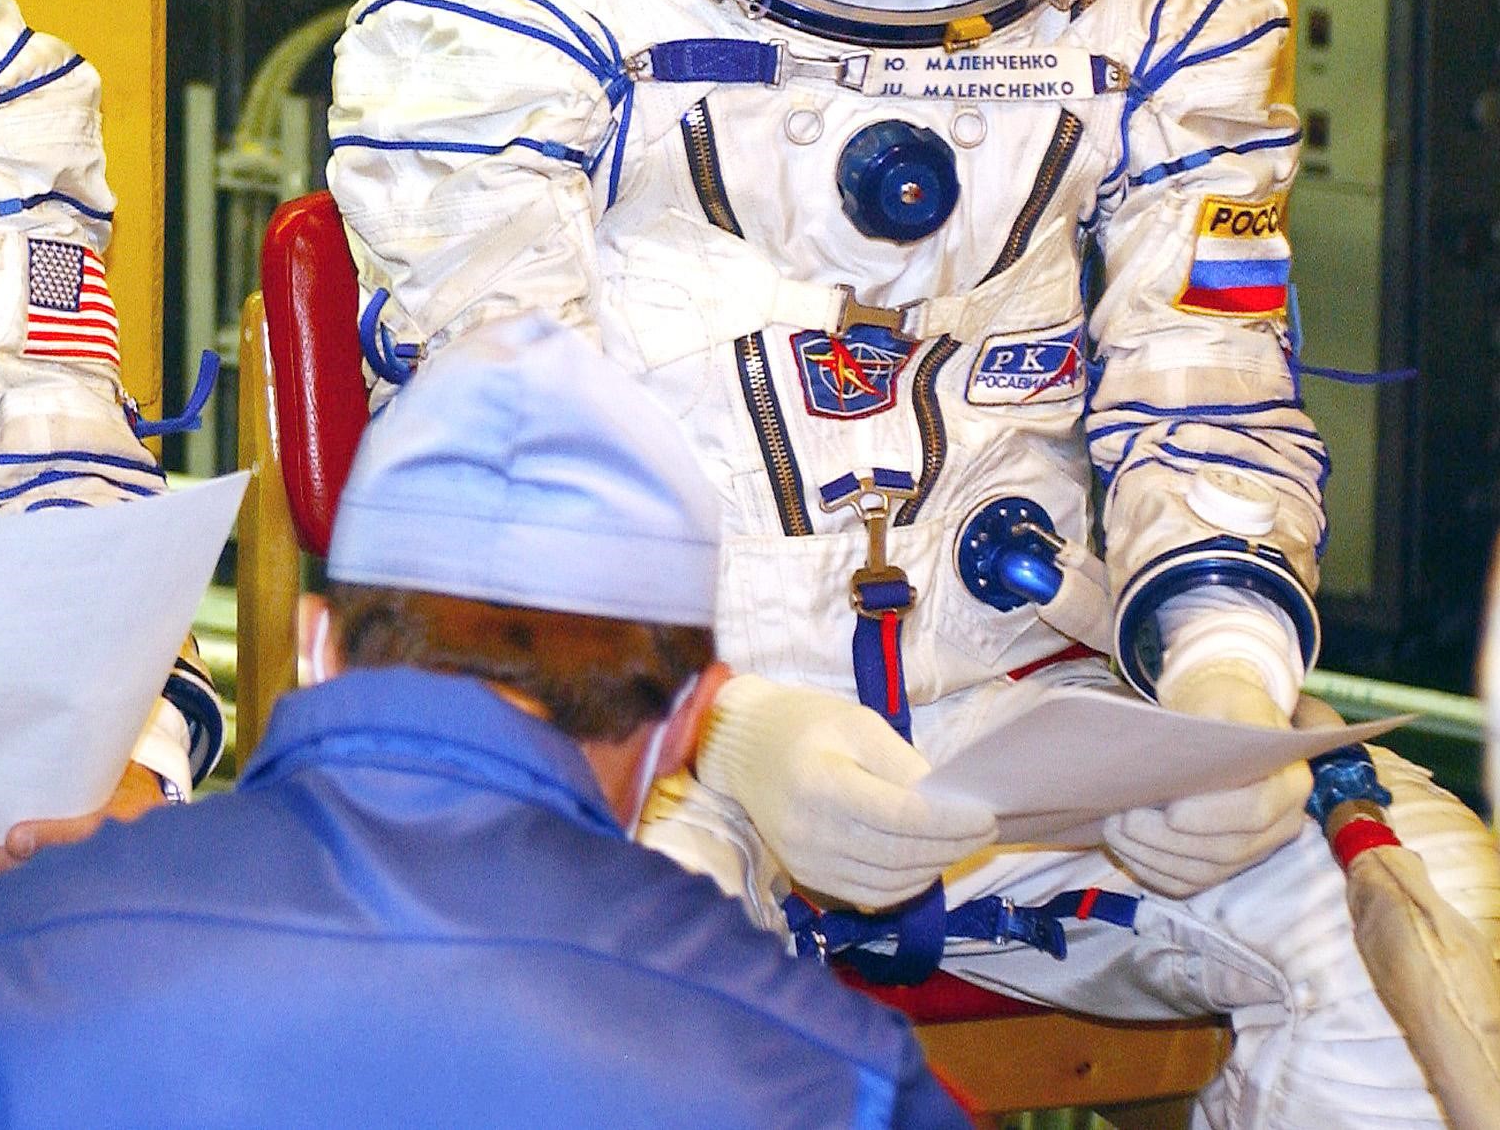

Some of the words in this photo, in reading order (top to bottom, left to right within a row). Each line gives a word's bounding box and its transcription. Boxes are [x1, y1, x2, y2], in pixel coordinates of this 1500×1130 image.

[925, 54, 1058, 71] МАЛЕНЧЕНКО
[923, 81, 1075, 99] MALENCHENKO
[1209, 205, 1279, 237] РОСС
